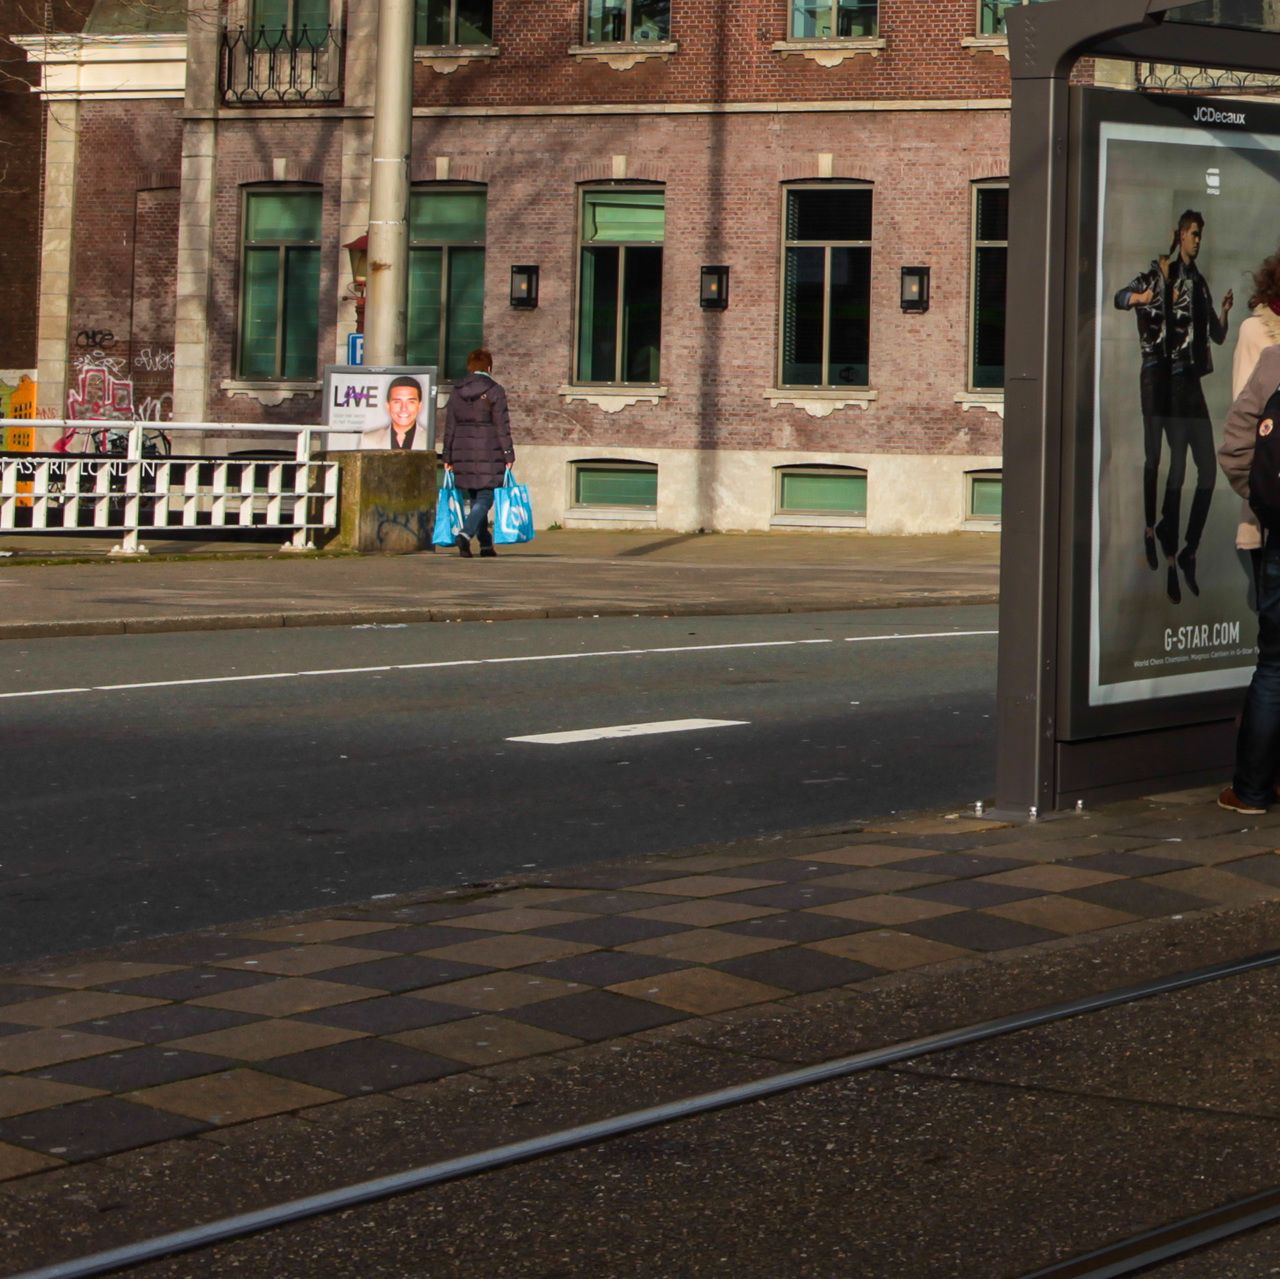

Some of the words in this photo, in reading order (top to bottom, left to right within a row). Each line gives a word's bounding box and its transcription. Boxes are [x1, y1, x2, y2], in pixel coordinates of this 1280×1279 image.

[1193, 106, 1246, 125] JCDecaux
[334, 385, 379, 408] LIVE
[1164, 621, 1240, 652] G-STAR.COM
